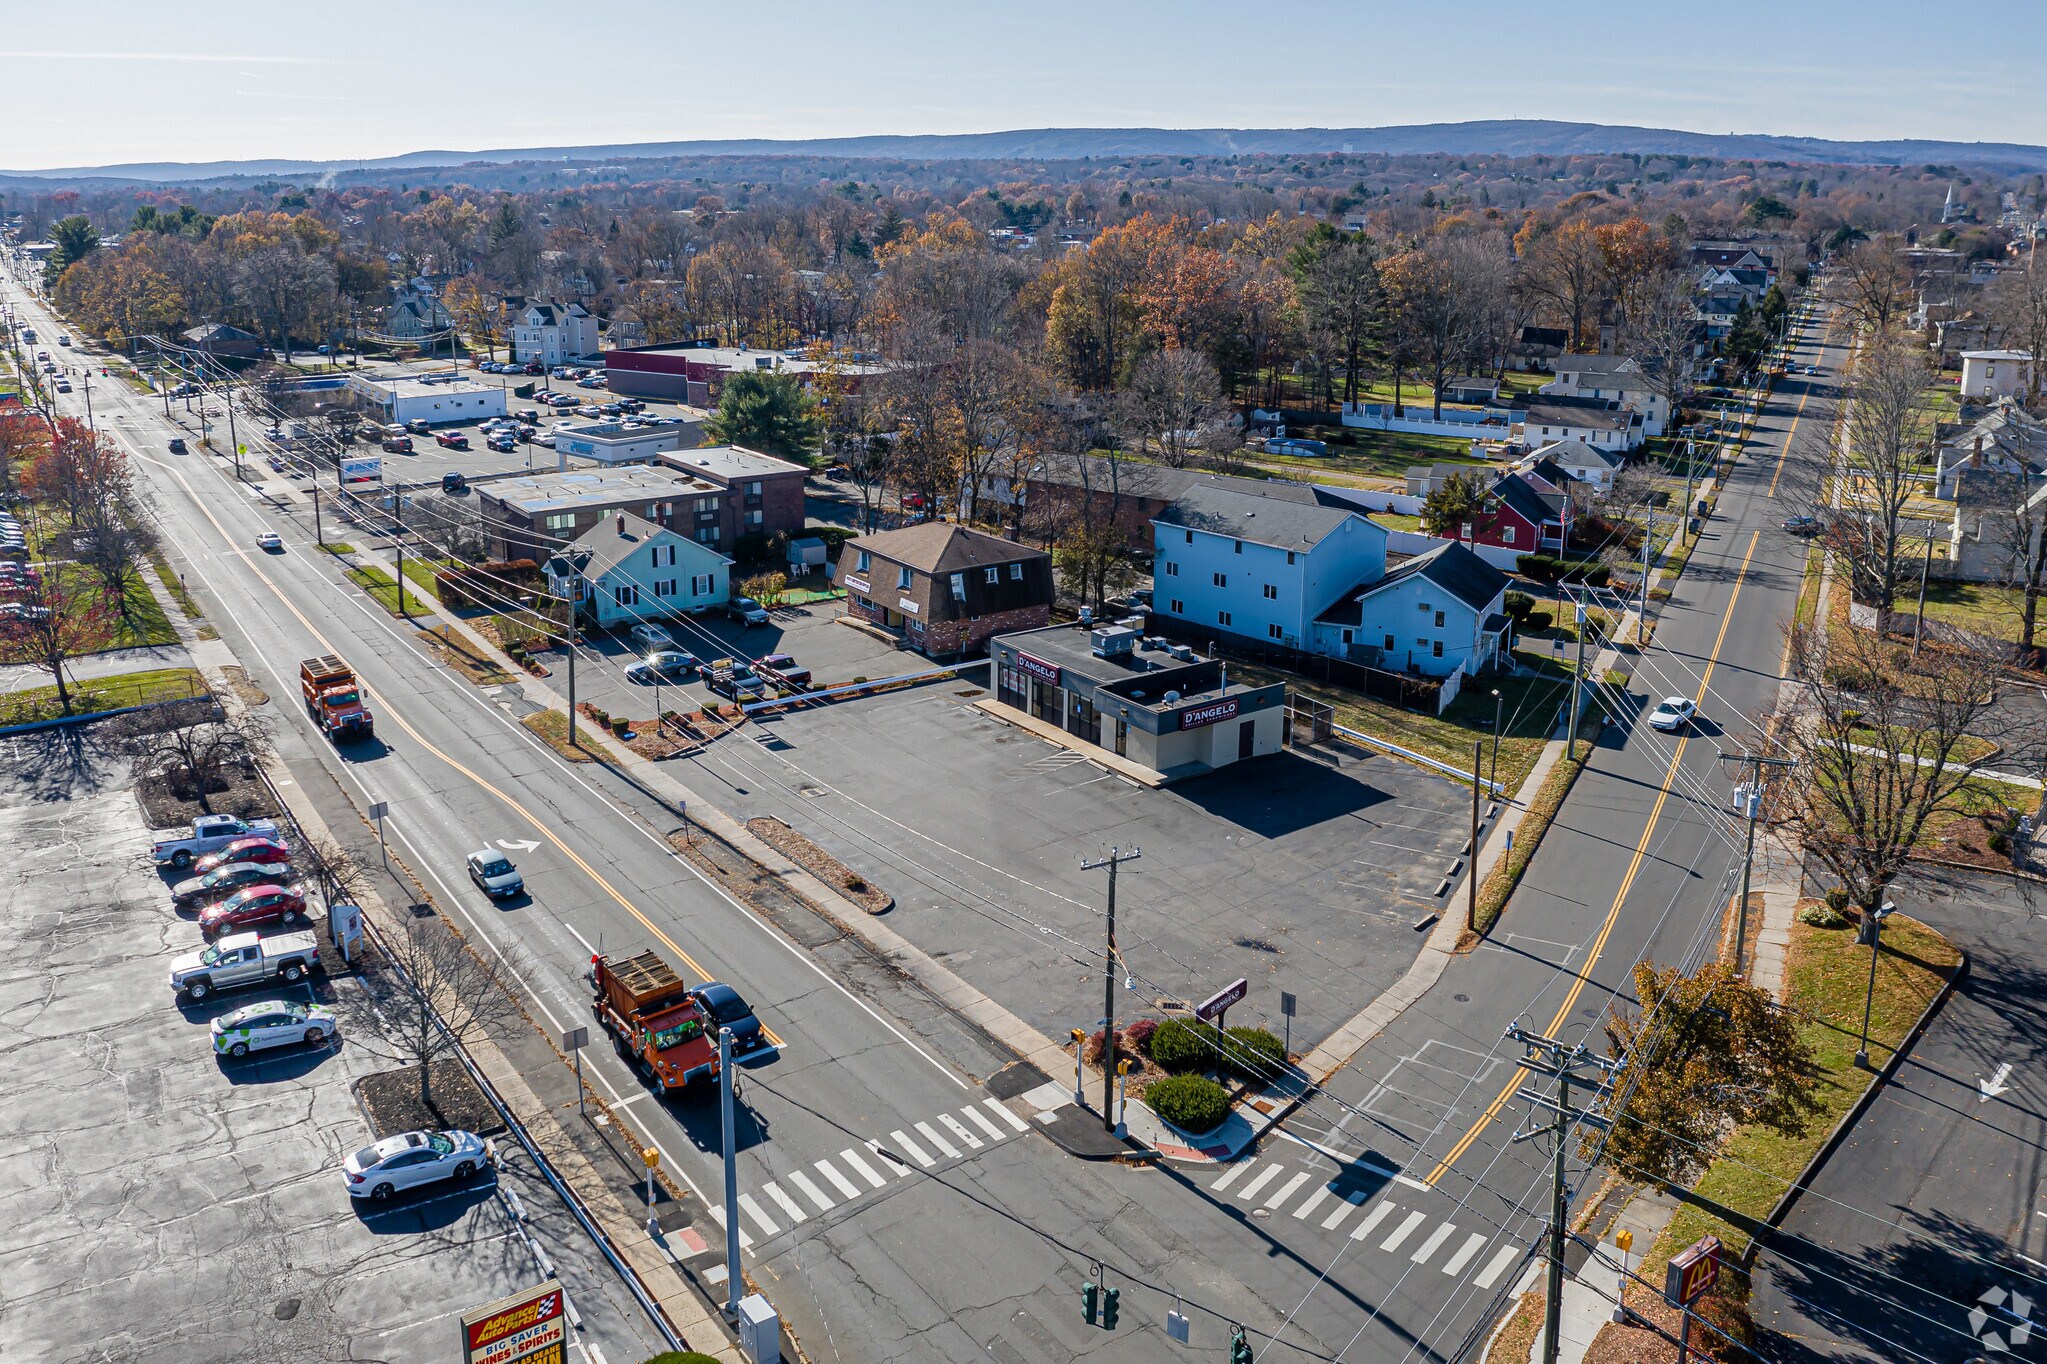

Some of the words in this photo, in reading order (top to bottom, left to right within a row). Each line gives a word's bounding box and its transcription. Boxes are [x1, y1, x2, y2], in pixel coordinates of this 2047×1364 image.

[1019, 656, 1056, 679] D'ANGELO
[1185, 704, 1236, 723] D'ANGELO
[475, 1326, 505, 1344] Auto
[504, 1314, 534, 1333] Parts
[483, 1304, 536, 1333] Advance
[486, 1341, 506, 1355] BIG
[510, 1323, 548, 1345] SAVER
[518, 1328, 560, 1353] SPIRITS
[533, 1343, 561, 1360] DEANE
